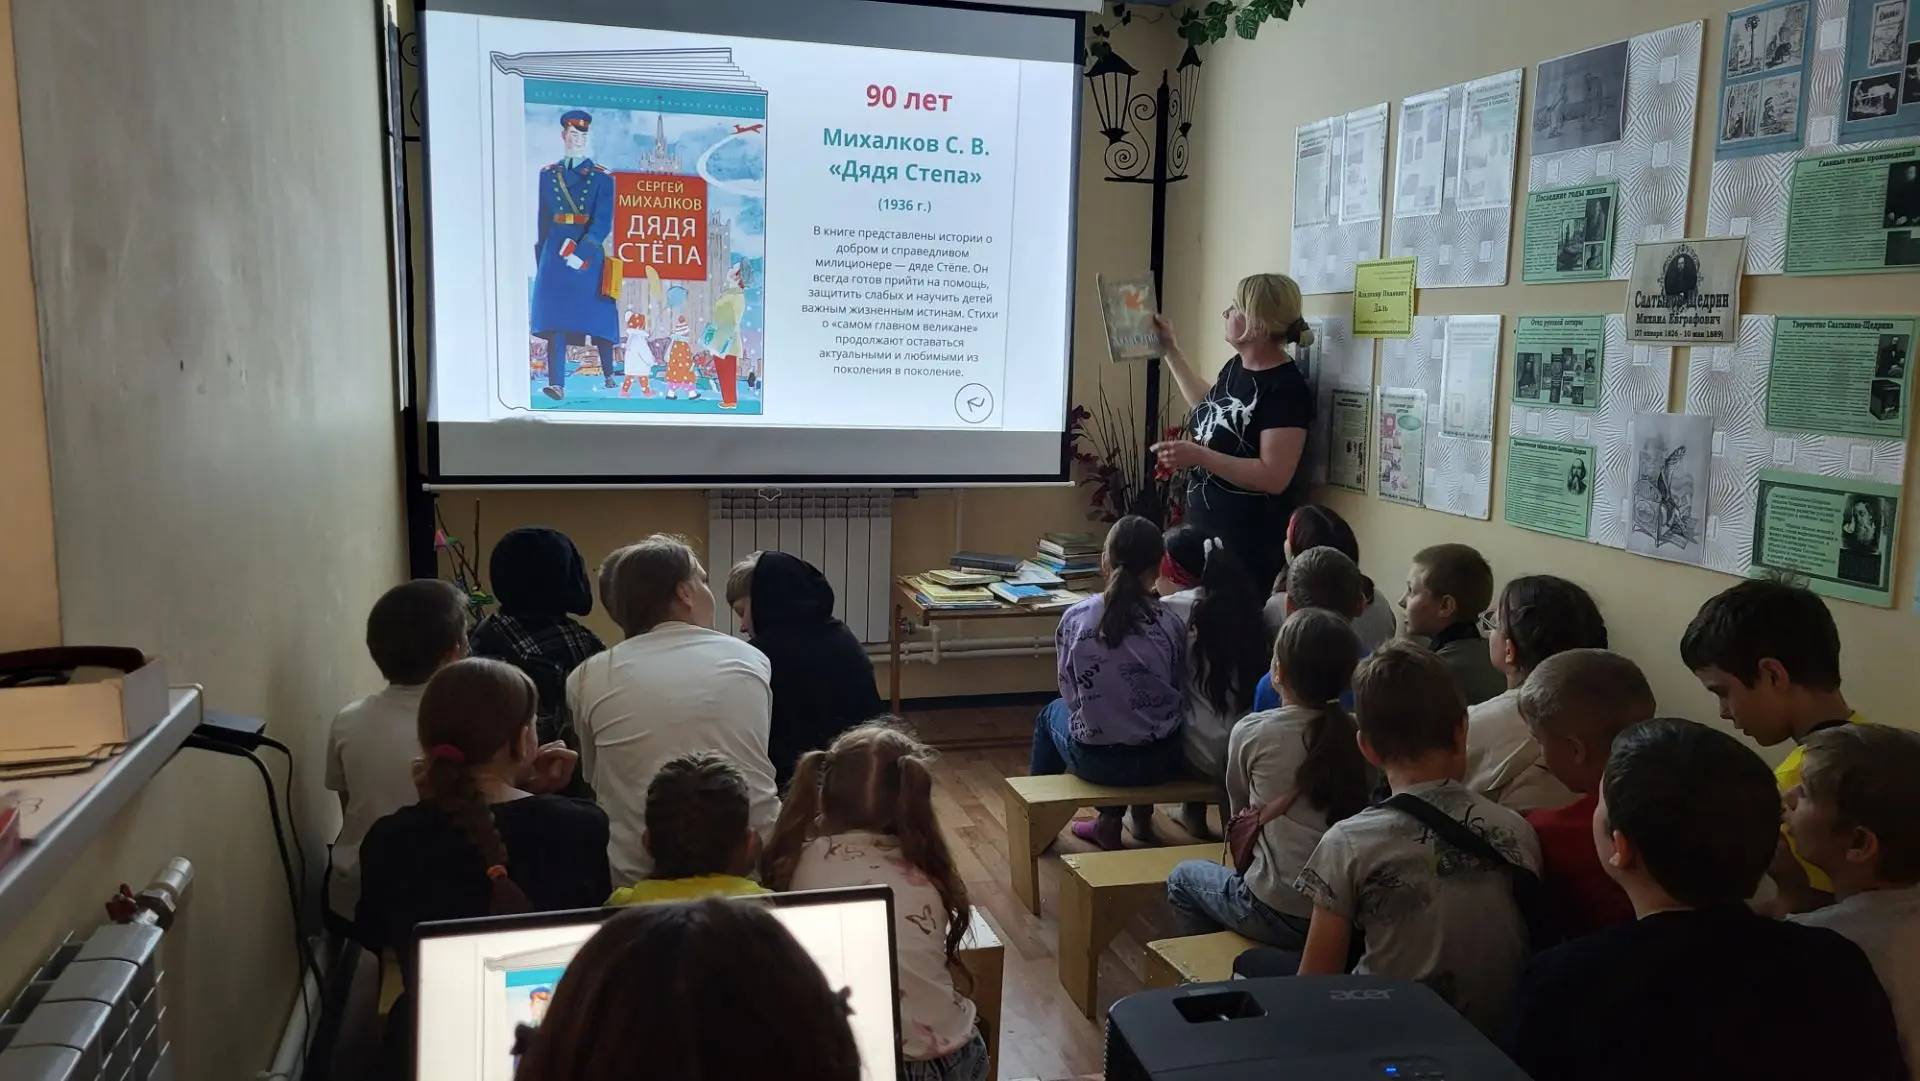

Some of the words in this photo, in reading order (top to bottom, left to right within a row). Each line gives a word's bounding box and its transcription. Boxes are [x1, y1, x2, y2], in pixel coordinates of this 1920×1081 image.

[866, 84, 897, 109] 90
[903, 92, 953, 112] лет
[823, 128, 939, 153] Михалков
[945, 136, 964, 155] С.
[971, 137, 990, 156] В.
[829, 160, 898, 183] «Дядя
[905, 163, 982, 184] Степа»
[637, 179, 684, 194] СЕРГЕЙ
[619, 194, 702, 211] МИХАЛКОВ
[878, 198, 914, 211] (1936
[917, 200, 932, 213] г.)
[627, 214, 696, 240] ДЯДЯ
[813, 226, 821, 236] В
[823, 227, 856, 237] книге
[858, 229, 936, 241] представлены
[938, 233, 983, 244] истории
[985, 235, 993, 243] о
[618, 240, 702, 266] СТЁПА
[835, 243, 879, 256] добром
[881, 247, 889, 255] и
[891, 247, 969, 258] справедливом
[815, 258, 892, 271] милиционере
[908, 262, 934, 273] дяде
[936, 262, 971, 273] Стёпе.
[973, 264, 989, 274] Он
[813, 273, 849, 285] всегда
[851, 275, 883, 285] готов
[884, 276, 925, 288] прийти
[927, 279, 940, 287] на
[943, 279, 990, 290] помощь,
[808, 288, 862, 299] защитить
[864, 289, 905, 300] слабых
[906, 292, 914, 301] и
[916, 293, 960, 304] научить
[962, 293, 993, 304] детей
[801, 304, 847, 314] важным
[849, 306, 914, 317] жизненным
[916, 308, 965, 318] истинам.
[967, 308, 999, 319] Стихи
[822, 319, 829, 328] о
[831, 320, 873, 330] «самом
[875, 321, 920, 331] главном
[922, 322, 978, 333] великане»
[835, 335, 904, 346] продолжают
[906, 336, 965, 348] оставаться
[819, 349, 892, 361] актуальными
[894, 352, 901, 360] и
[903, 351, 965, 362] любимыми
[966, 354, 979, 362] из
[833, 365, 892, 375] поколения
[894, 367, 901, 375] в
[903, 367, 964, 377] поколение.
[1328, 988, 1396, 1001] acer
